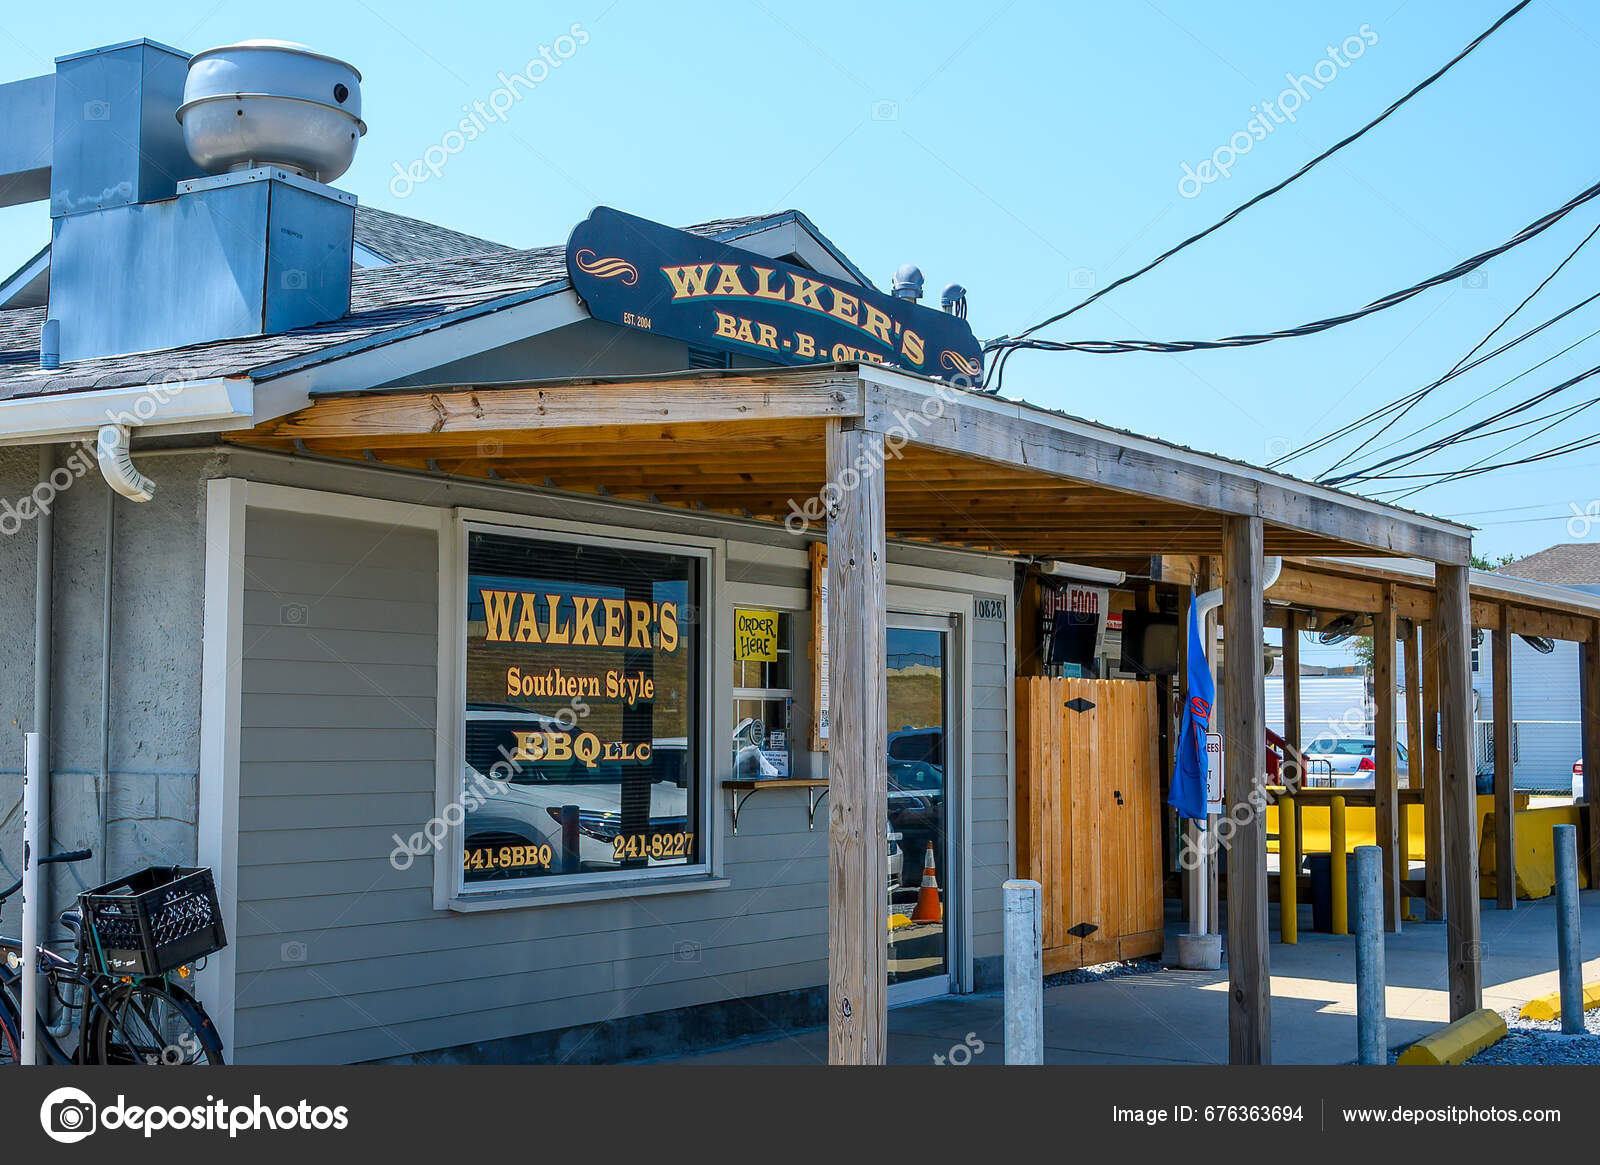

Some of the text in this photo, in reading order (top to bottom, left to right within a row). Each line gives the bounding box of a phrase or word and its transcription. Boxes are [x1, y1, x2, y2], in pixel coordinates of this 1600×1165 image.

[623, 312, 652, 329] EST. 2004
[662, 263, 926, 367] WALKER'S
[480, 589, 680, 653] WALKER'S
[974, 599, 1003, 619] 10828
[507, 666, 654, 706] Southern Style
[512, 731, 651, 768] BBQ LLC
[464, 832, 694, 869] 241-8BBQ 241-8227
